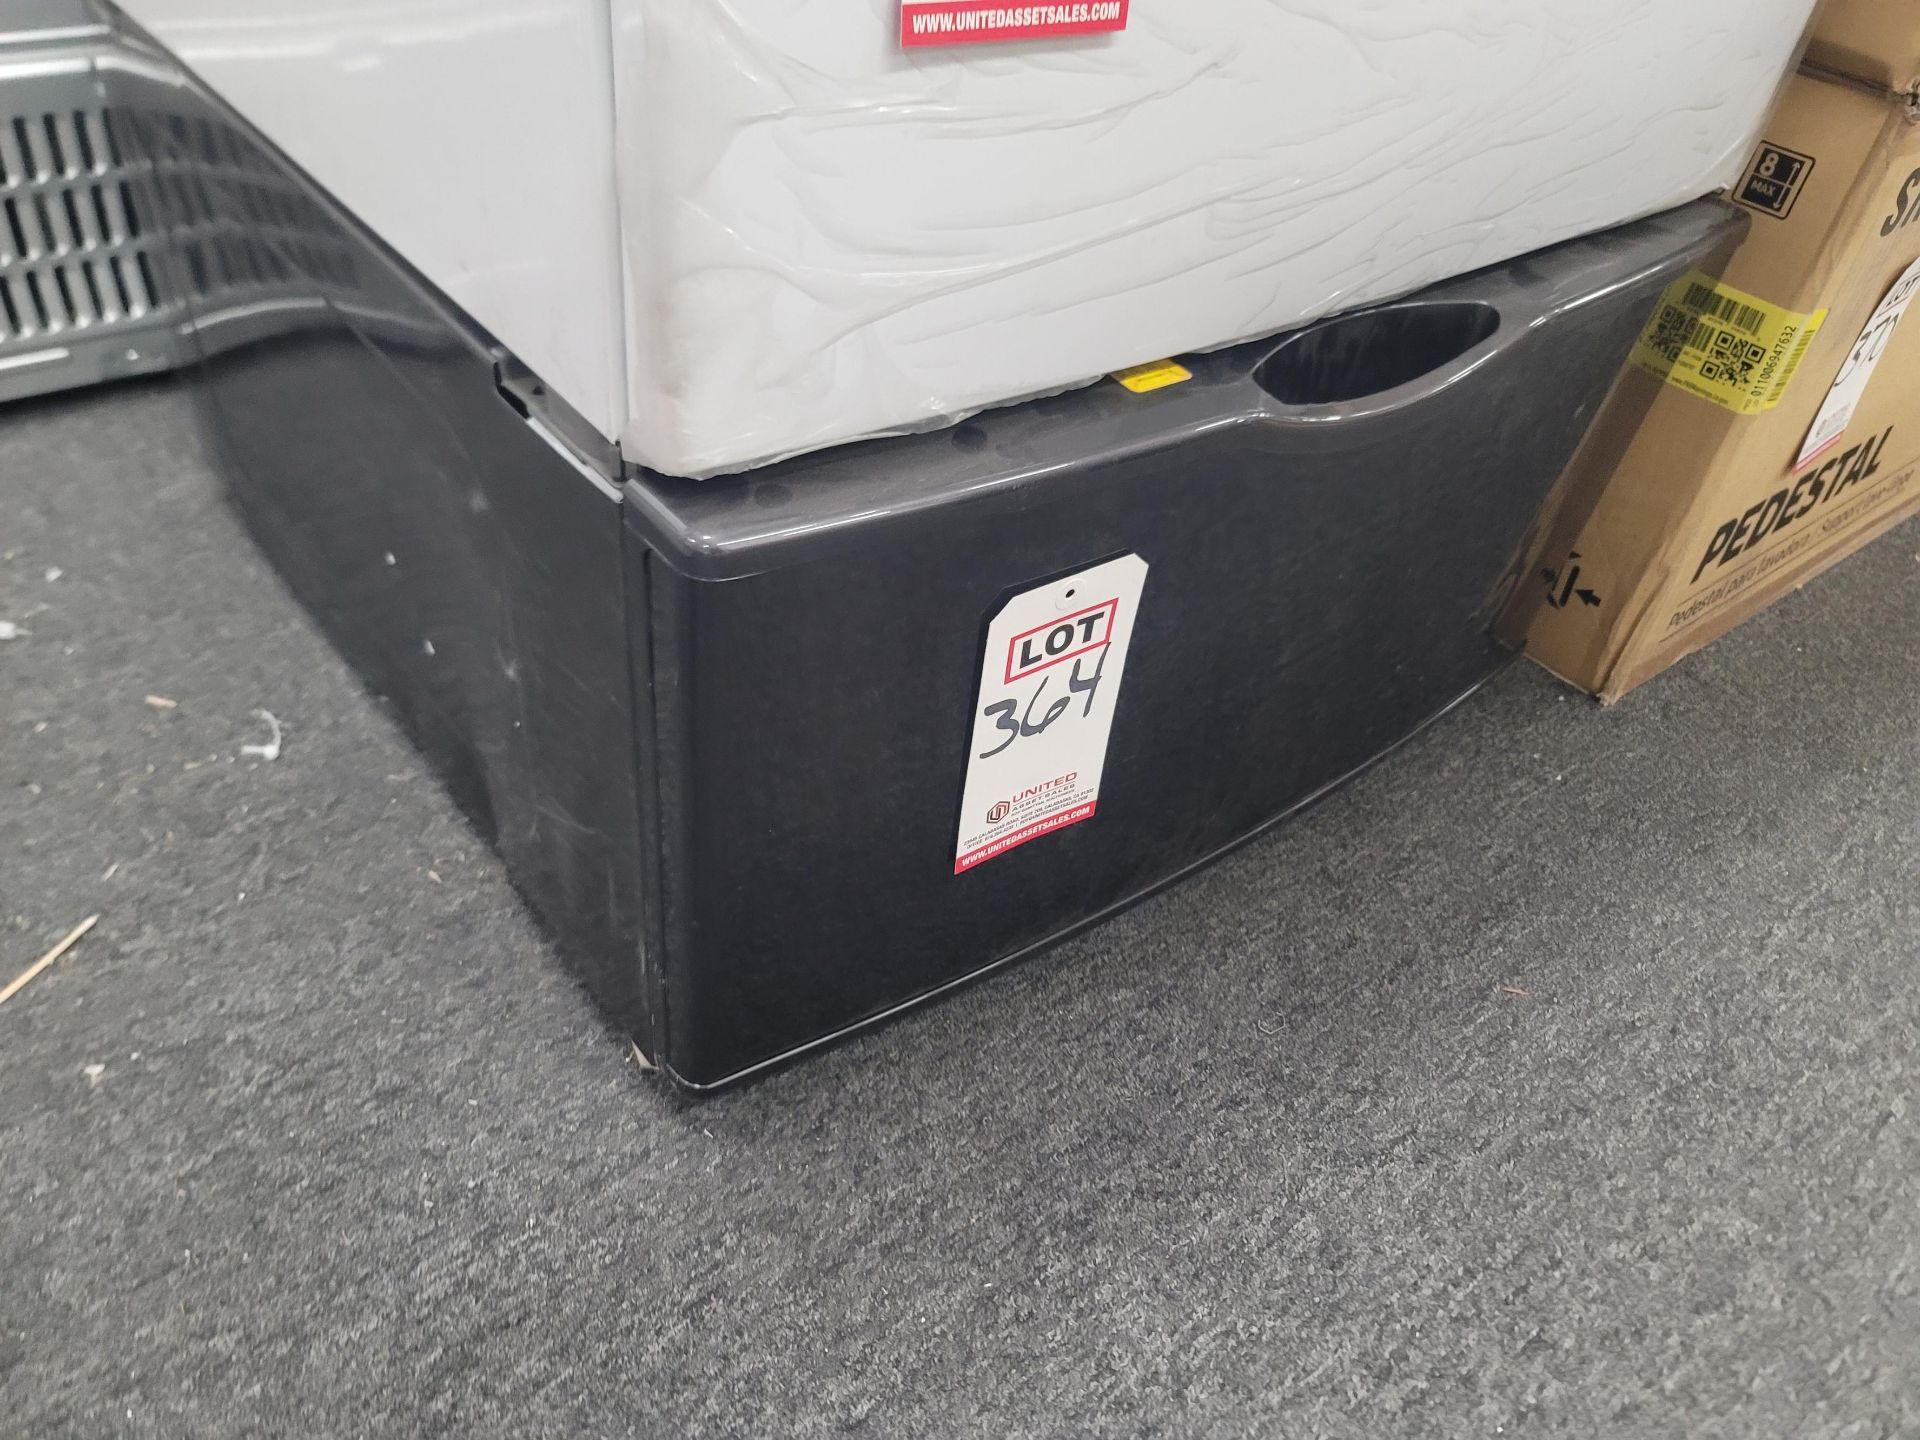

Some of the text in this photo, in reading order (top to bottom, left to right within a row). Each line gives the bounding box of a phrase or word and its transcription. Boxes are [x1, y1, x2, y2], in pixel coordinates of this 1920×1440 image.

[912, 2, 1120, 34] WWW.UNITEDASSETSALES.COM
[1760, 153, 1779, 177] 8
[1751, 179, 1776, 196] MAX
[1751, 325, 1797, 397] 011006947632
[1690, 425, 1893, 585] PEDESTAL
[1020, 612, 1104, 669] LOT
[979, 642, 1111, 759] 364
[1012, 772, 1077, 803] UNITED
[1012, 784, 1075, 813] ASSET SALES
[962, 805, 1090, 867] WWW.UNITEDASSETSALES.COM
